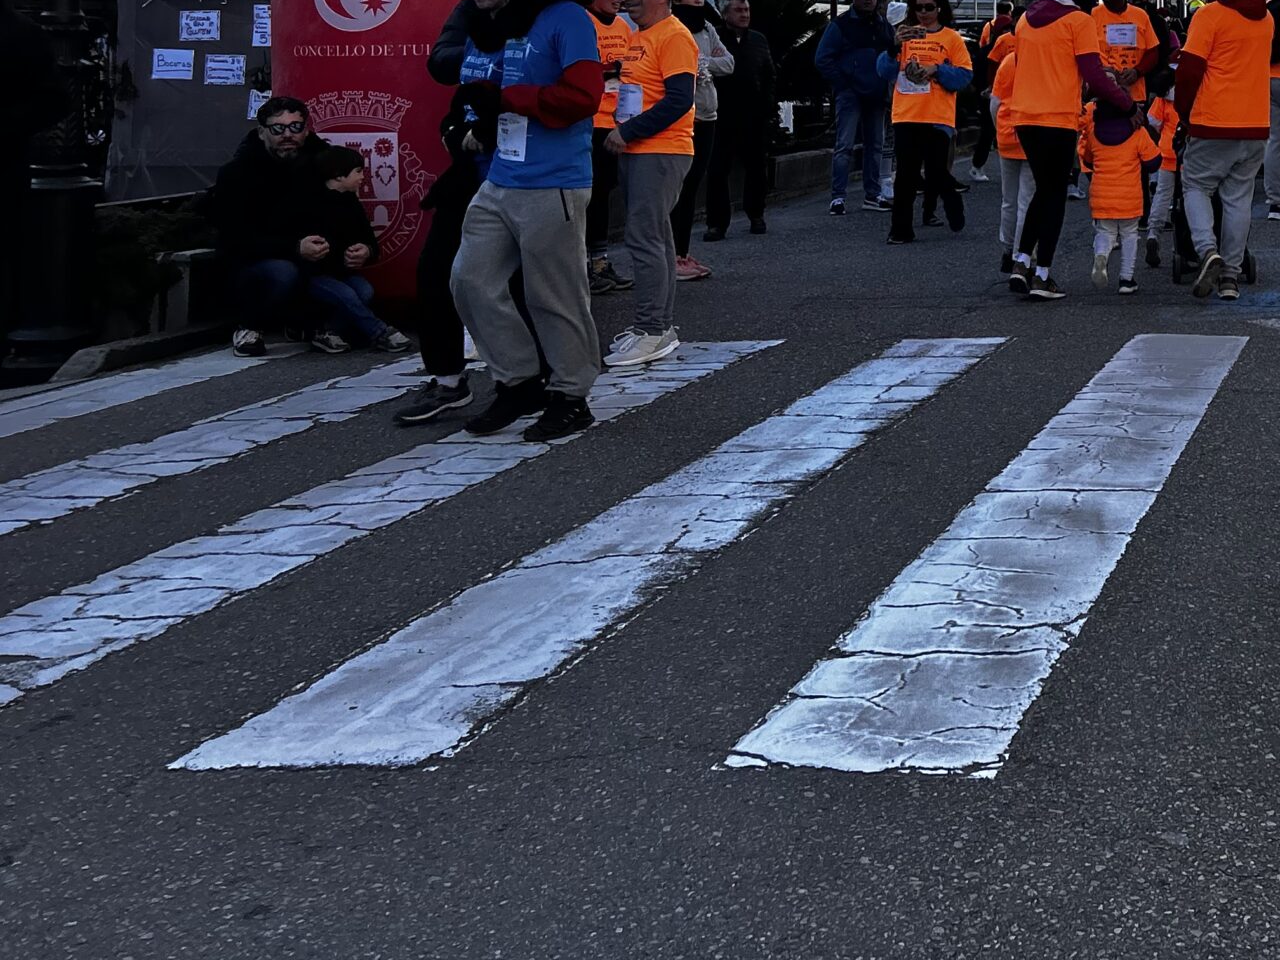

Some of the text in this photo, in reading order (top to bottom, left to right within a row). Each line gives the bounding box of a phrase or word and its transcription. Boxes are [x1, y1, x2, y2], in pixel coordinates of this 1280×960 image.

[293, 43, 432, 57] CONCELLO DE TUI
[381, 212, 418, 257] ALENÇA
